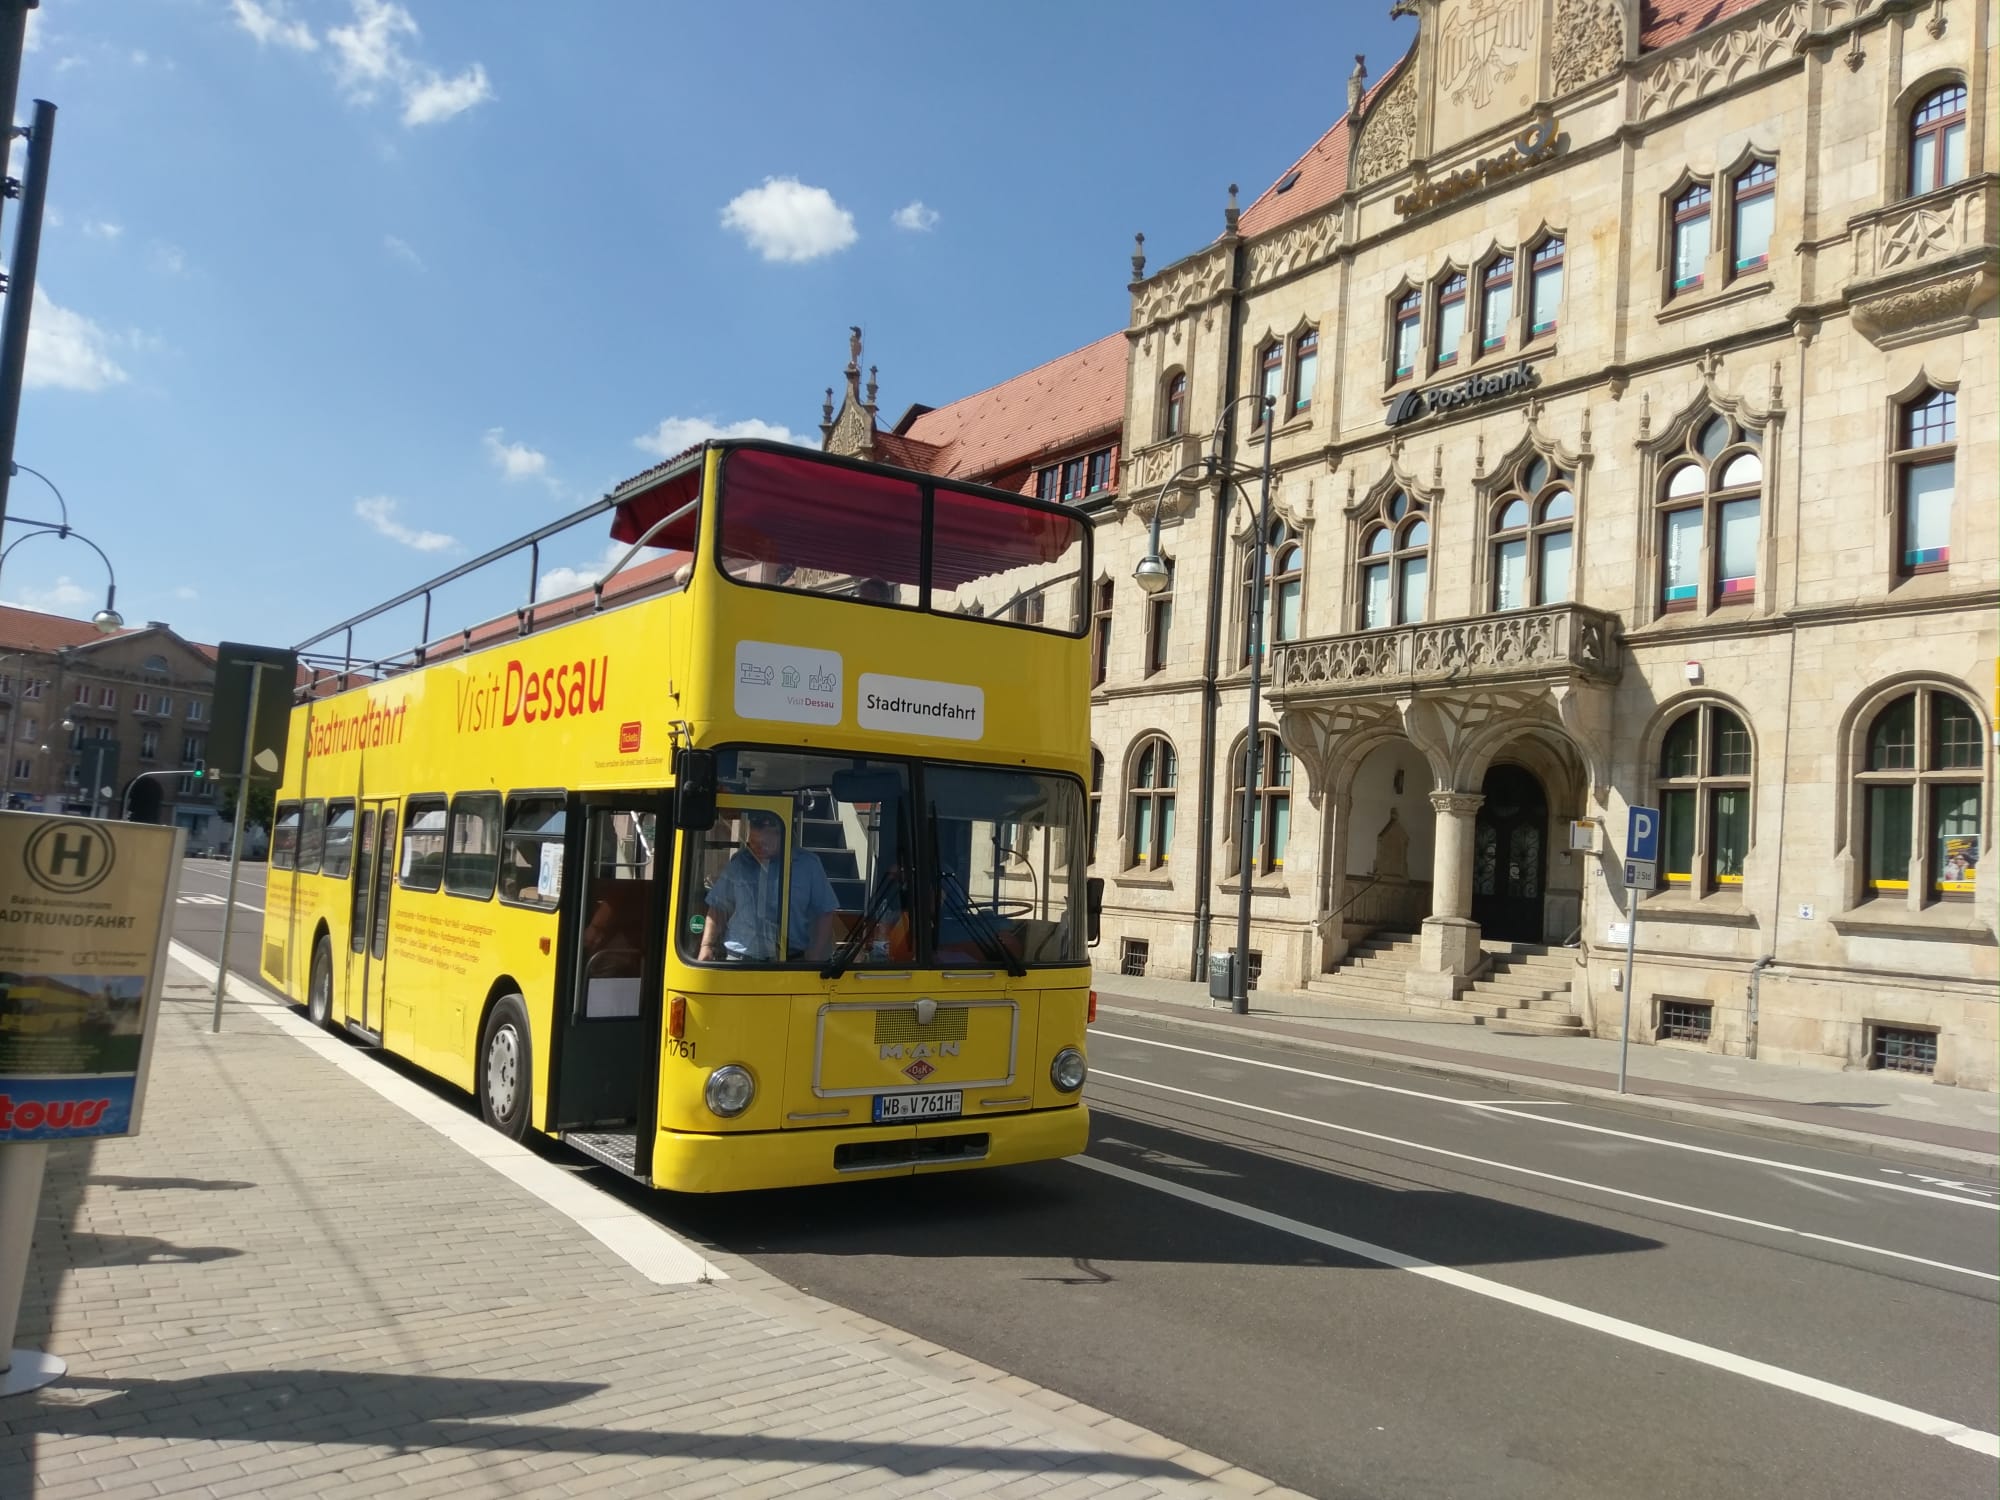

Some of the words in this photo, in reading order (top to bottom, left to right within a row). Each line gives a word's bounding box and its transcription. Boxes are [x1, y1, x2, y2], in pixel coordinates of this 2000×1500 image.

[1427, 361, 1533, 411] Postbank
[457, 672, 500, 734] Visit
[502, 655, 609, 727] Dessau
[804, 697, 835, 709] Dessau
[866, 694, 977, 721] Stadtrundfahrt
[306, 696, 407, 760] Stadtrundfahrt
[1633, 813, 1652, 853] P
[50, 832, 93, 877] H
[669, 1039, 697, 1060] 1761
[883, 1098, 900, 1116] WB
[910, 1096, 918, 1114] V
[921, 1094, 953, 1113] 761H
